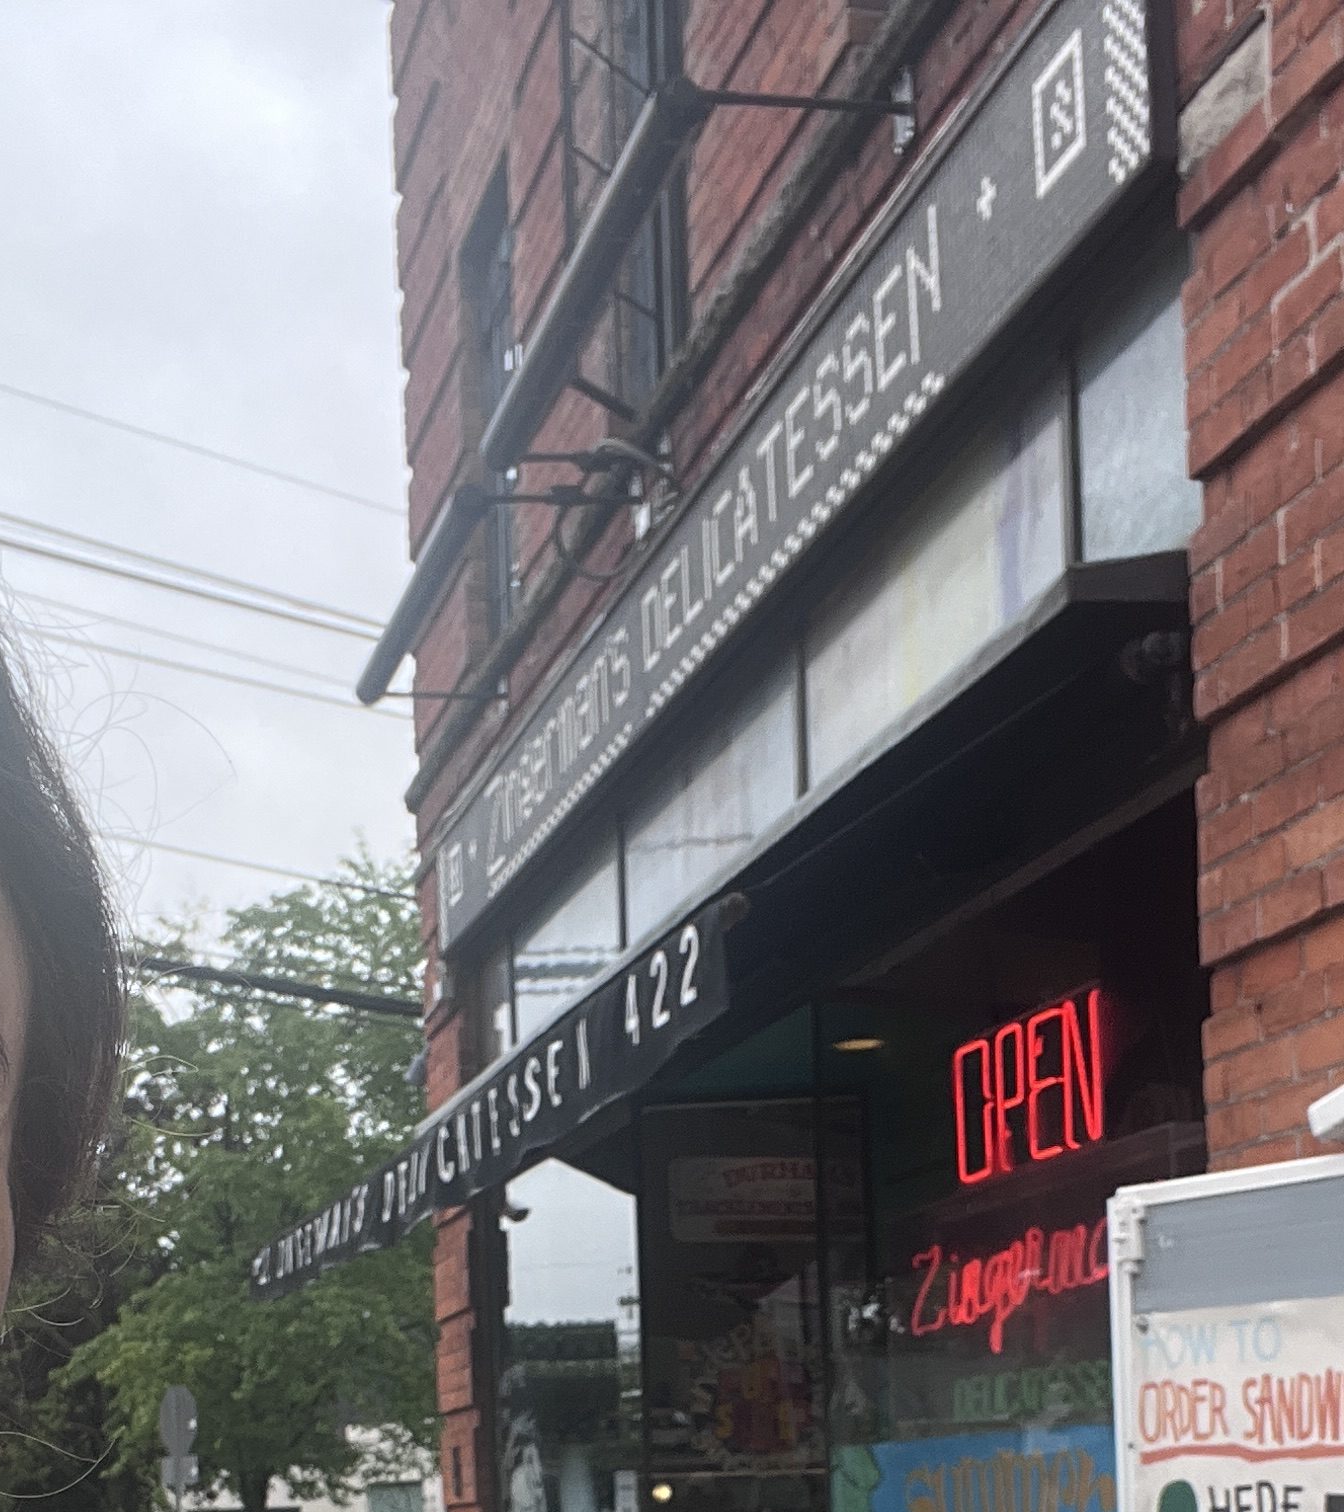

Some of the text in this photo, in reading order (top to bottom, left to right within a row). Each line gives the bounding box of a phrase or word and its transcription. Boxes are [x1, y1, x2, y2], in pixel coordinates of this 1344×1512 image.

[638, 203, 943, 673] DELICATESSEN
[624, 923, 700, 1046] 422
[952, 988, 1103, 1185] OPEN
[1228, 1316, 1282, 1363] TO
[1139, 1375, 1229, 1445] ORDER
